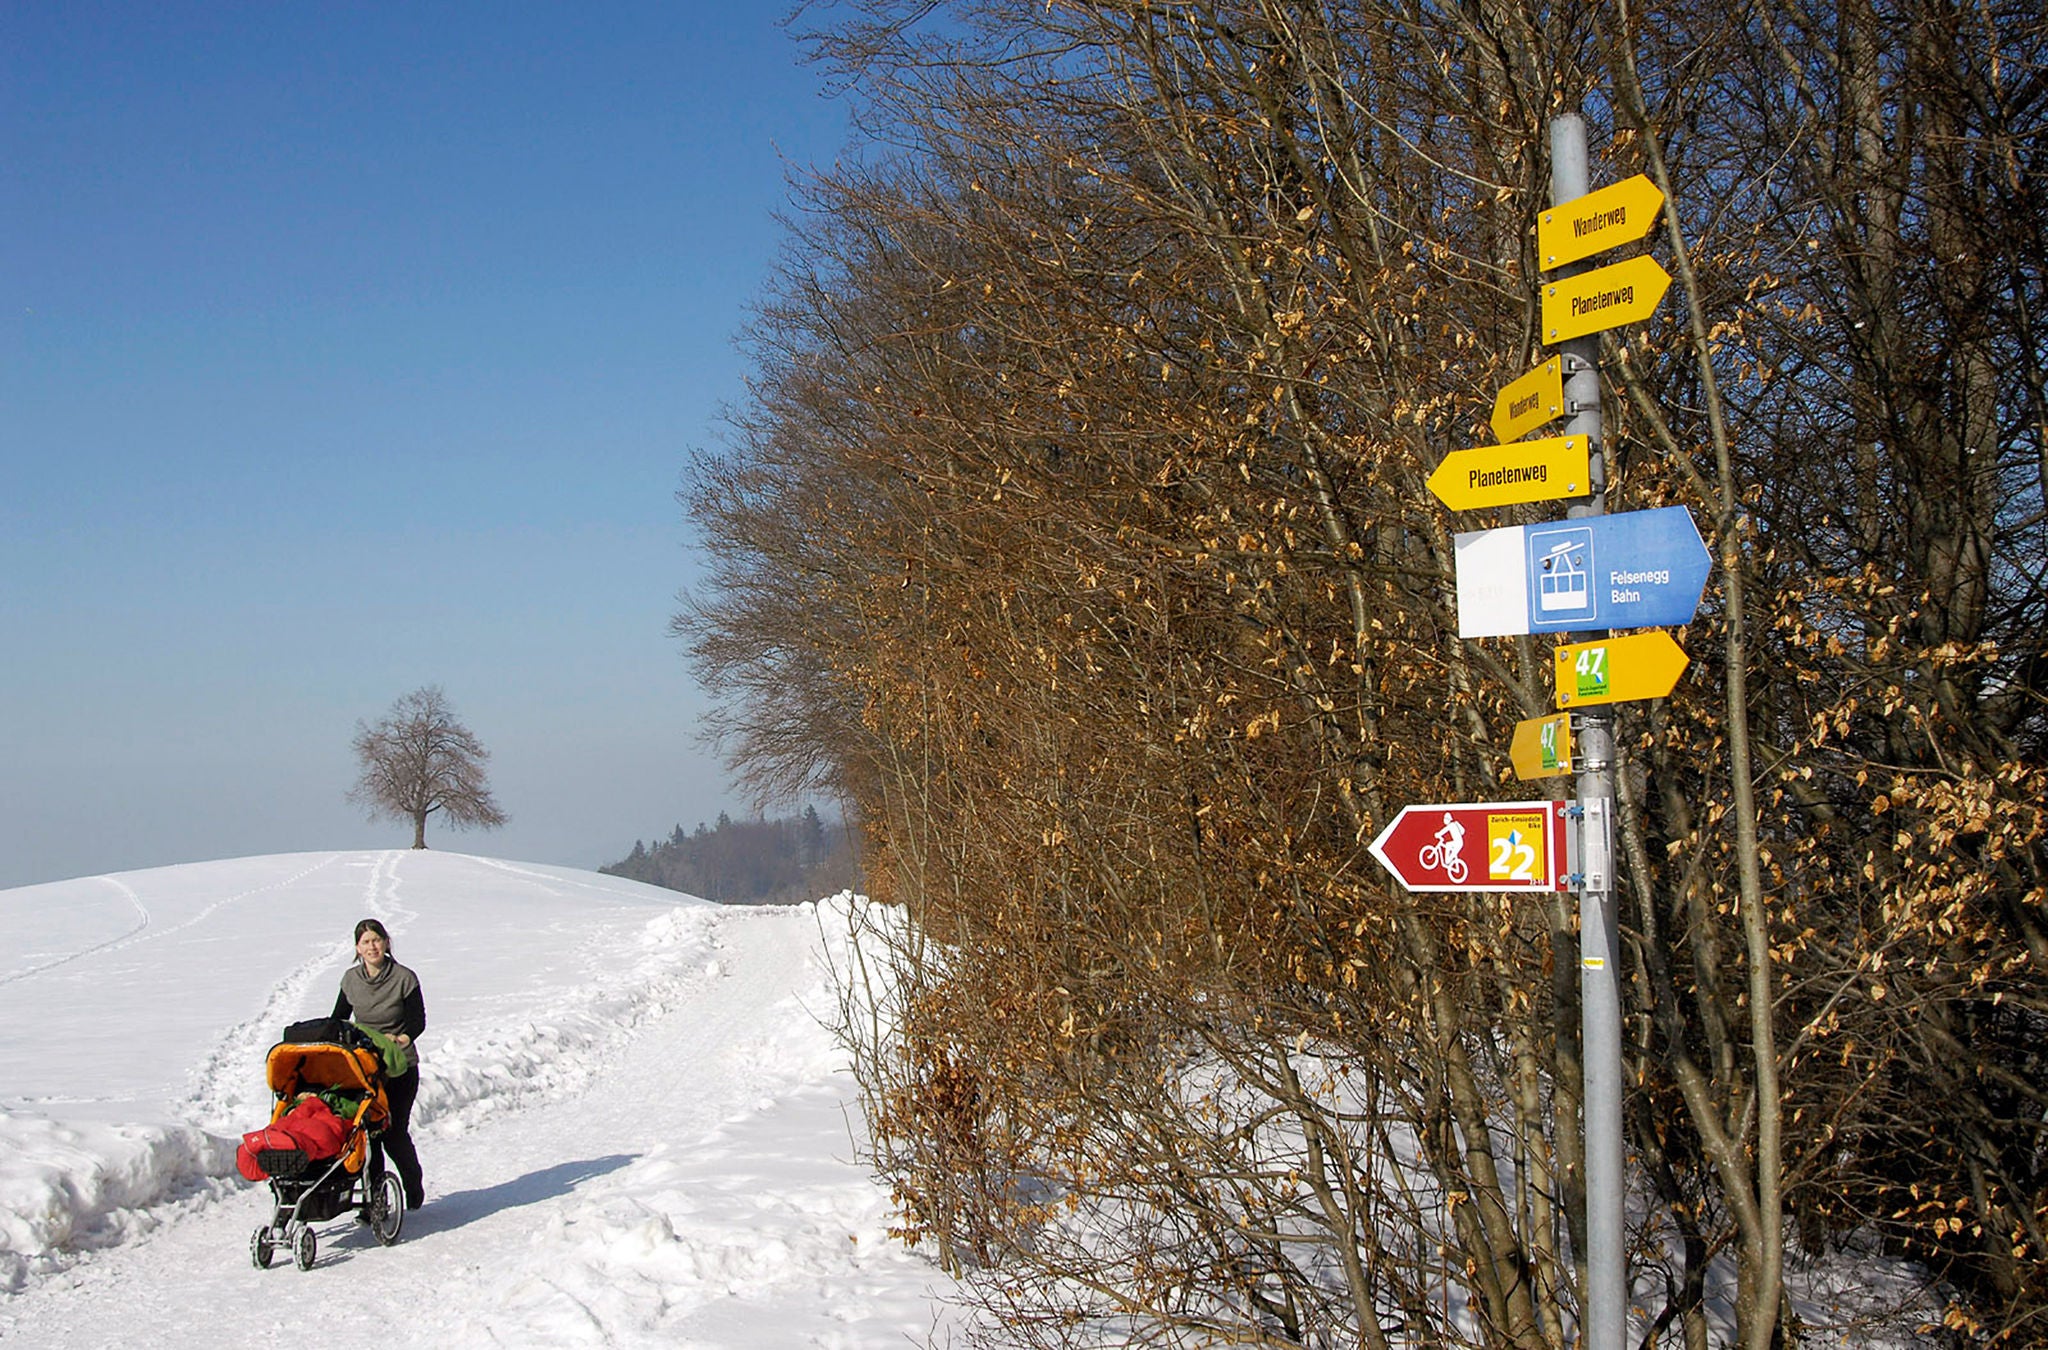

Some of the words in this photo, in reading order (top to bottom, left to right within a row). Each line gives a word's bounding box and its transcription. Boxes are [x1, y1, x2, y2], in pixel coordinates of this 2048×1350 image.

[1573, 207, 1626, 238] Wanderweg
[1572, 286, 1633, 317] Planetenweg
[1508, 391, 1539, 420] Wanderweg
[1470, 465, 1546, 488] Planetenweg
[1611, 570, 1669, 585] Felsenegg
[1612, 589, 1640, 603] Bahn
[1576, 647, 1604, 676] 47
[1540, 722, 1554, 748] 47
[1489, 838, 1535, 880] 22
